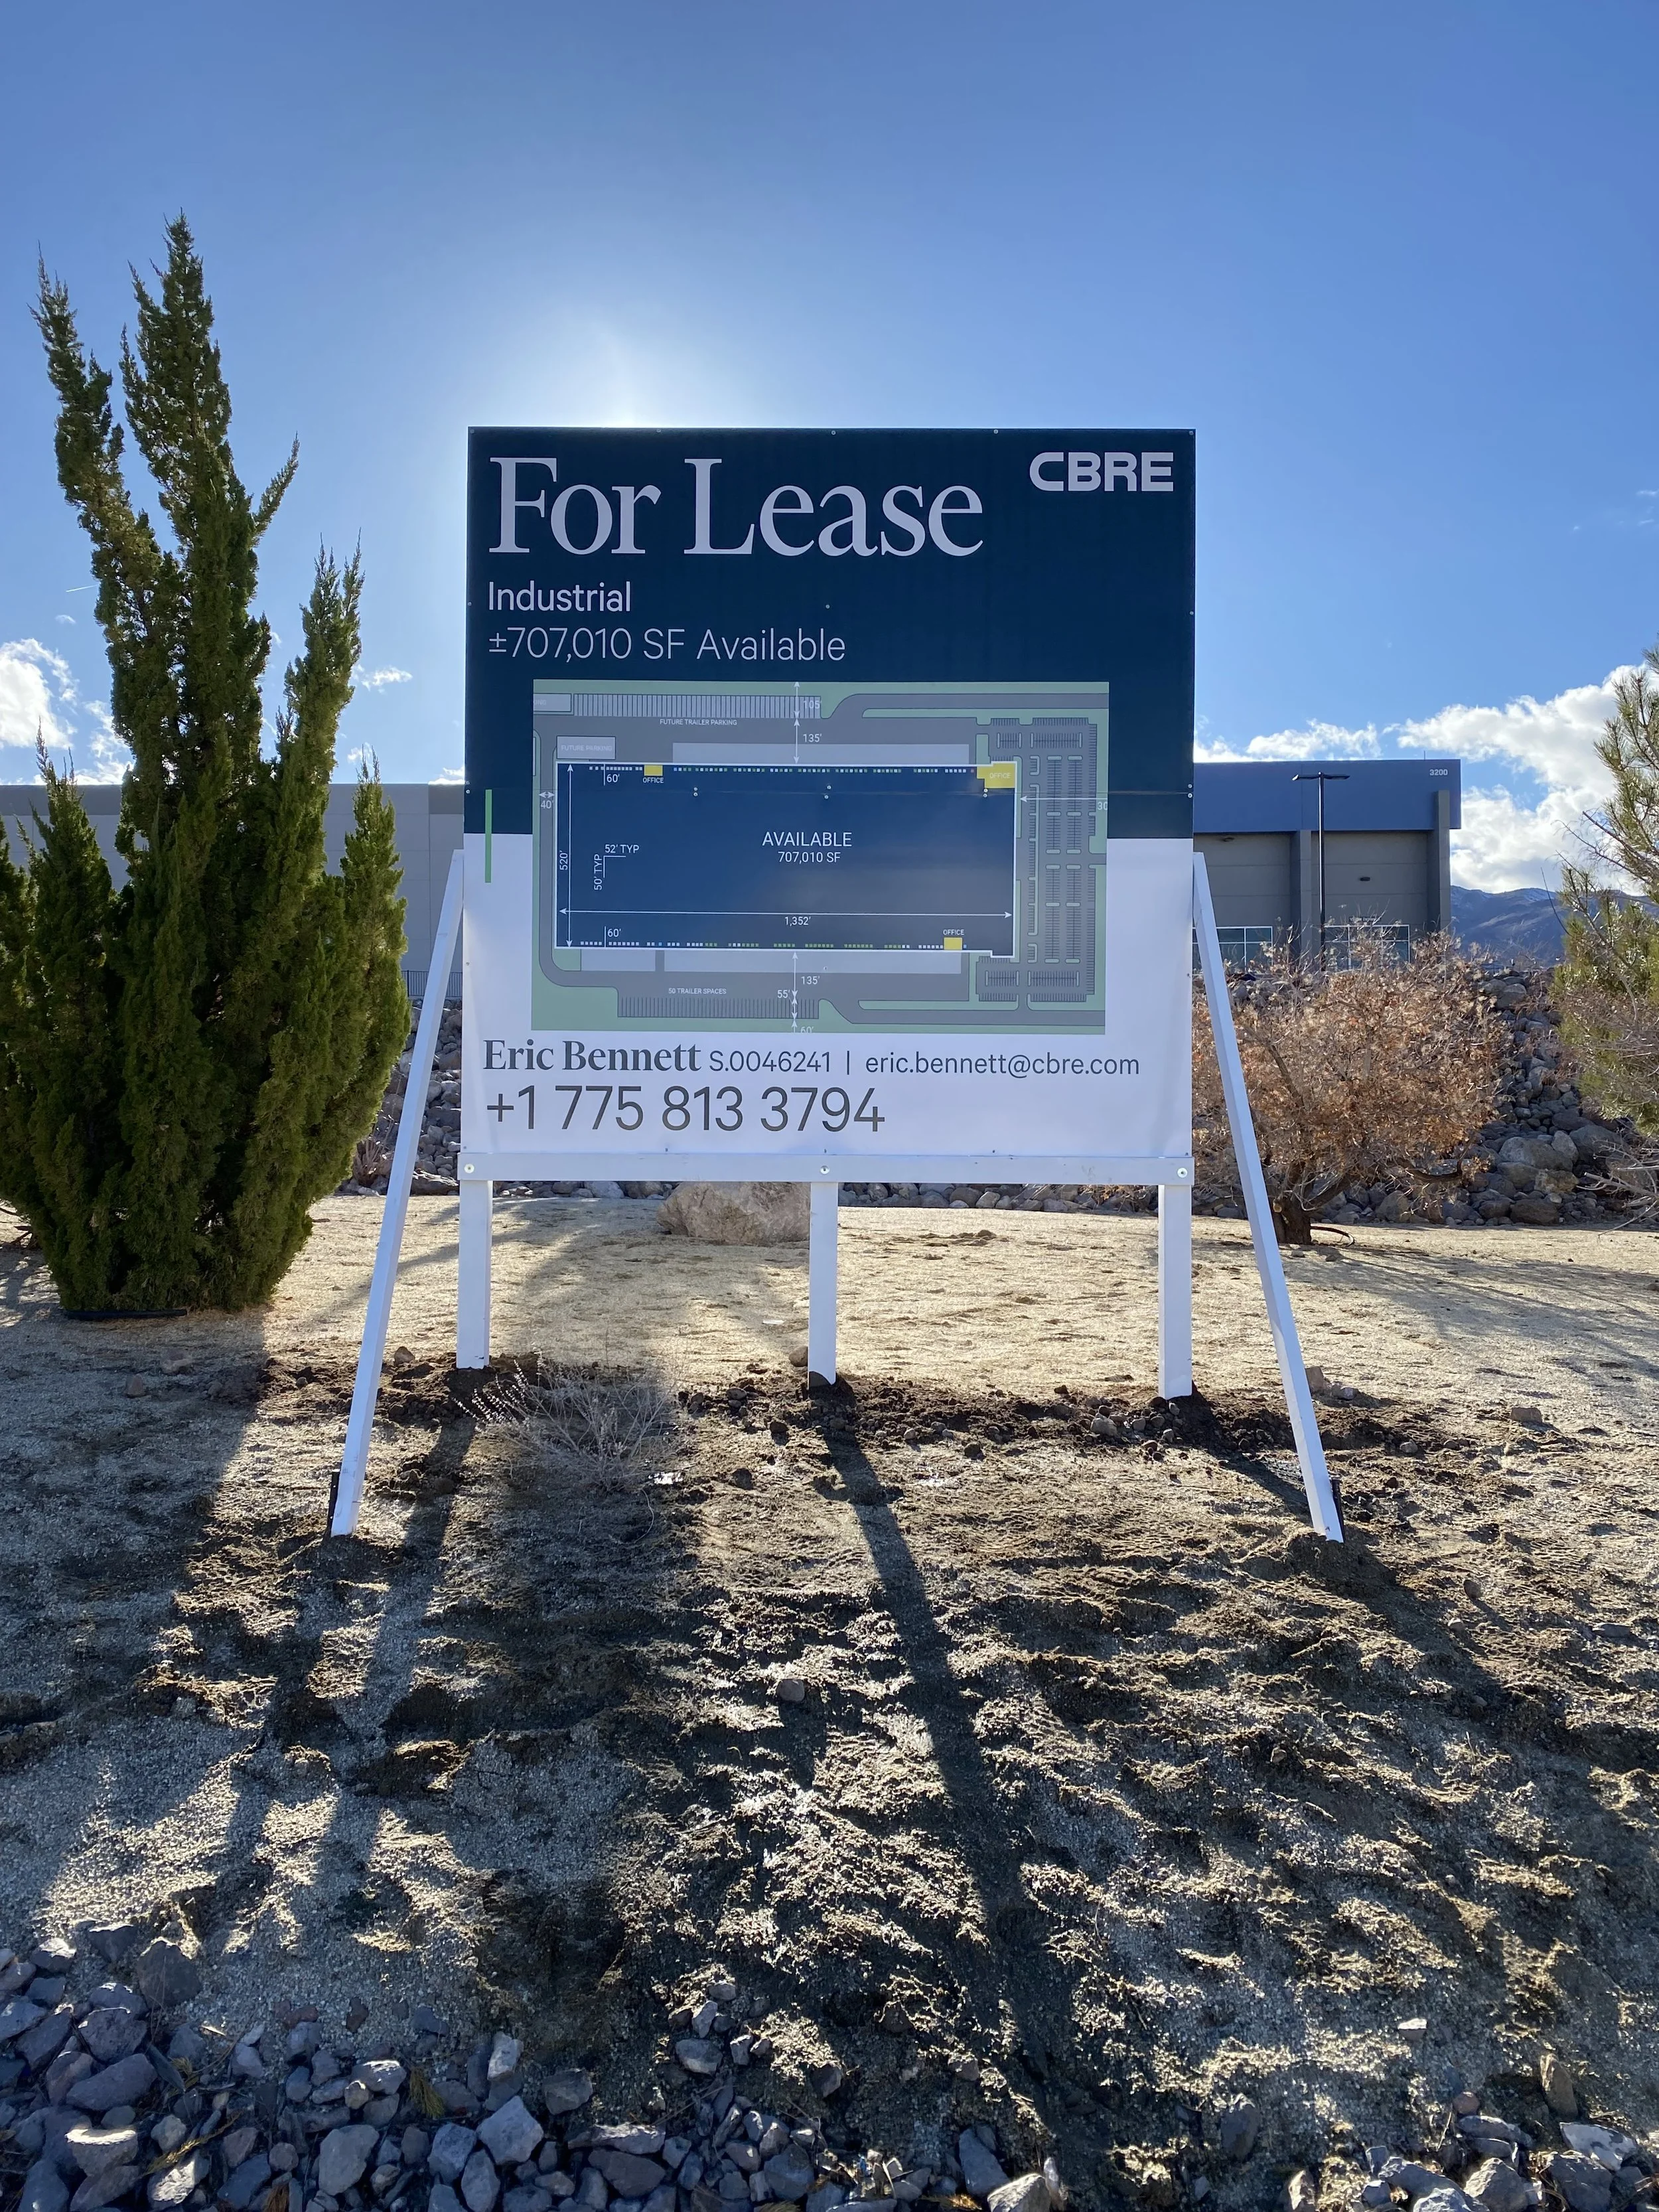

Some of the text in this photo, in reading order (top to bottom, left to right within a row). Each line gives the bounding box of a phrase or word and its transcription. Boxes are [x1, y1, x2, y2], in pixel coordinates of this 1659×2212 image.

[1029, 452, 1174, 492] CBRE
[489, 457, 983, 557] For Lease
[489, 580, 631, 612] Industrial
[489, 627, 846, 662] ±707,010 SF Available
[803, 733, 822, 743] 135'
[607, 774, 620, 783] 60'
[540, 800, 554, 809] 40'
[762, 832, 853, 847] AVAILABLE
[605, 844, 640, 853] 52' TYP
[559, 850, 568, 871] 520'
[778, 851, 841, 865] 707,010 SF
[593, 853, 603, 891] 50' TYP
[784, 916, 812, 927] 1,352'
[607, 928, 622, 937] 60'
[801, 976, 820, 985] 135'
[777, 990, 791, 998] 55'
[483, 1039, 554, 1071] Eric
[562, 1040, 701, 1072] Bennett
[709, 1050, 831, 1073] S.0046241
[865, 1051, 1140, 1079] eric.bennett@cbre.com
[486, 1085, 885, 1132] +1 775 813 3794
